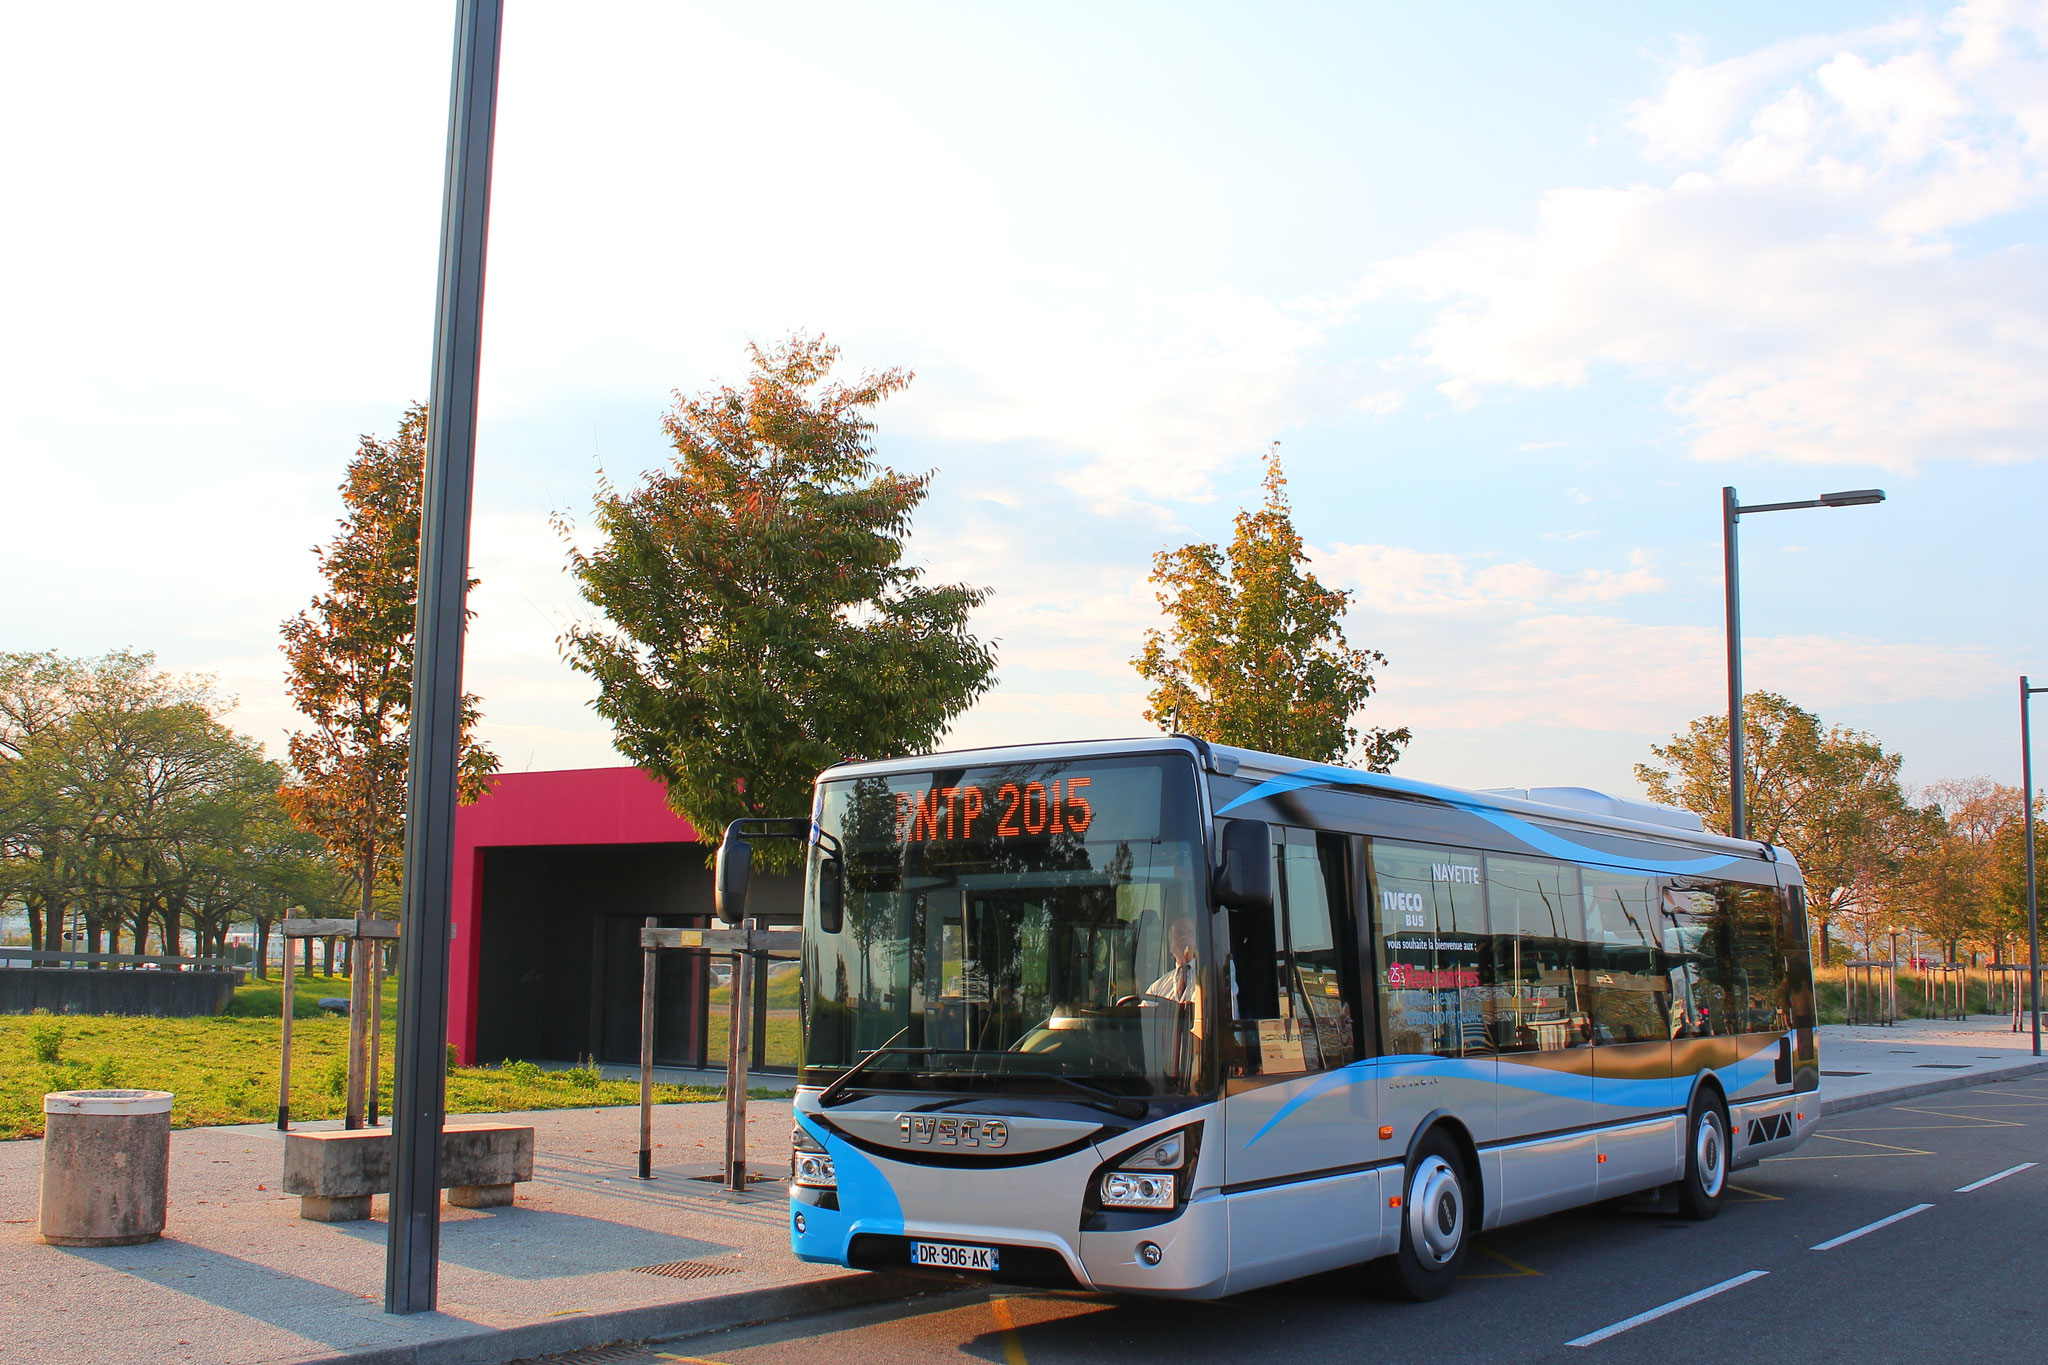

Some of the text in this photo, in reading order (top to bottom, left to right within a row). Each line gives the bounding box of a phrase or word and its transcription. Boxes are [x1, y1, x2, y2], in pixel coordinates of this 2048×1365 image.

[895, 777, 1092, 843] RNTP 2015
[1432, 863, 1480, 884] NAVETTE
[1383, 891, 1423, 912] IVECO
[1405, 914, 1424, 927] BUS
[1386, 939, 1402, 950] vous
[1402, 938, 1428, 950] souhaite
[1428, 938, 1434, 950] la
[1434, 938, 1463, 951] bienvenue
[1404, 963, 1480, 988] Rencontres
[1406, 1009, 1456, 1029] transport
[900, 1116, 1009, 1149] IVECO
[919, 1245, 990, 1268] DR-906-AK
